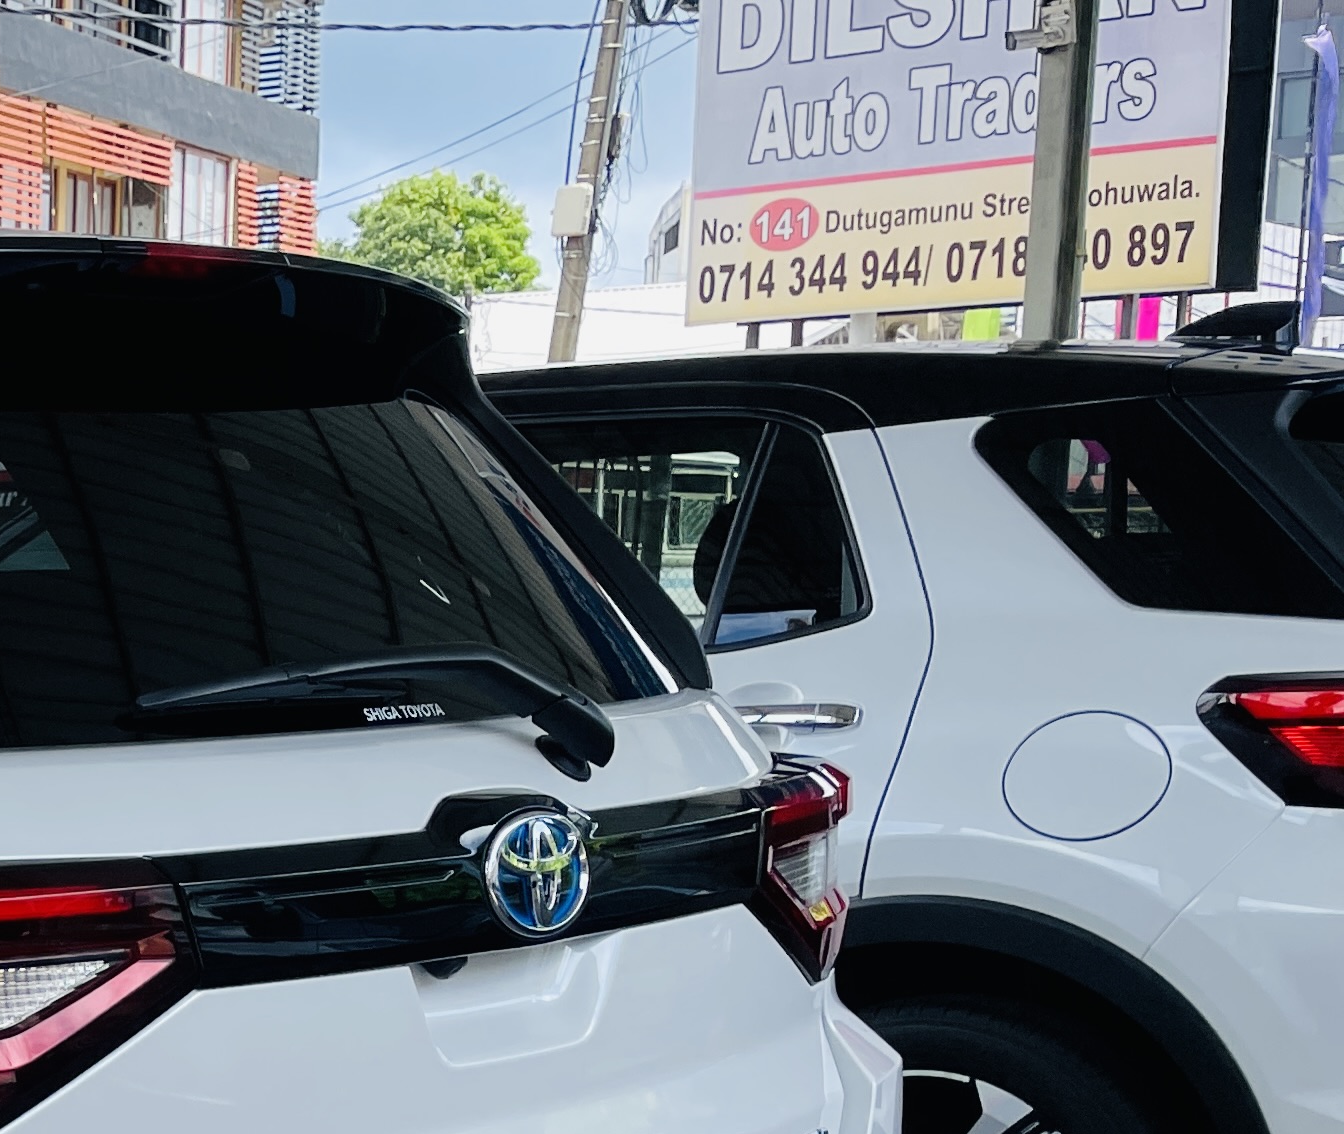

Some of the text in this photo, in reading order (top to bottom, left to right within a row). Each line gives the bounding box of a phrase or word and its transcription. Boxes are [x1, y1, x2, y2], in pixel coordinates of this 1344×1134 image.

[748, 57, 1157, 165] Auto Tradrs
[700, 174, 1201, 246] No: 141 Dutugamunu Stre ohuwala.
[698, 259, 776, 304] 0714
[788, 252, 848, 297] 344
[945, 235, 1029, 284] 0718
[1127, 220, 1196, 268] 897
[363, 702, 446, 722] SHIGA TOYOTA
